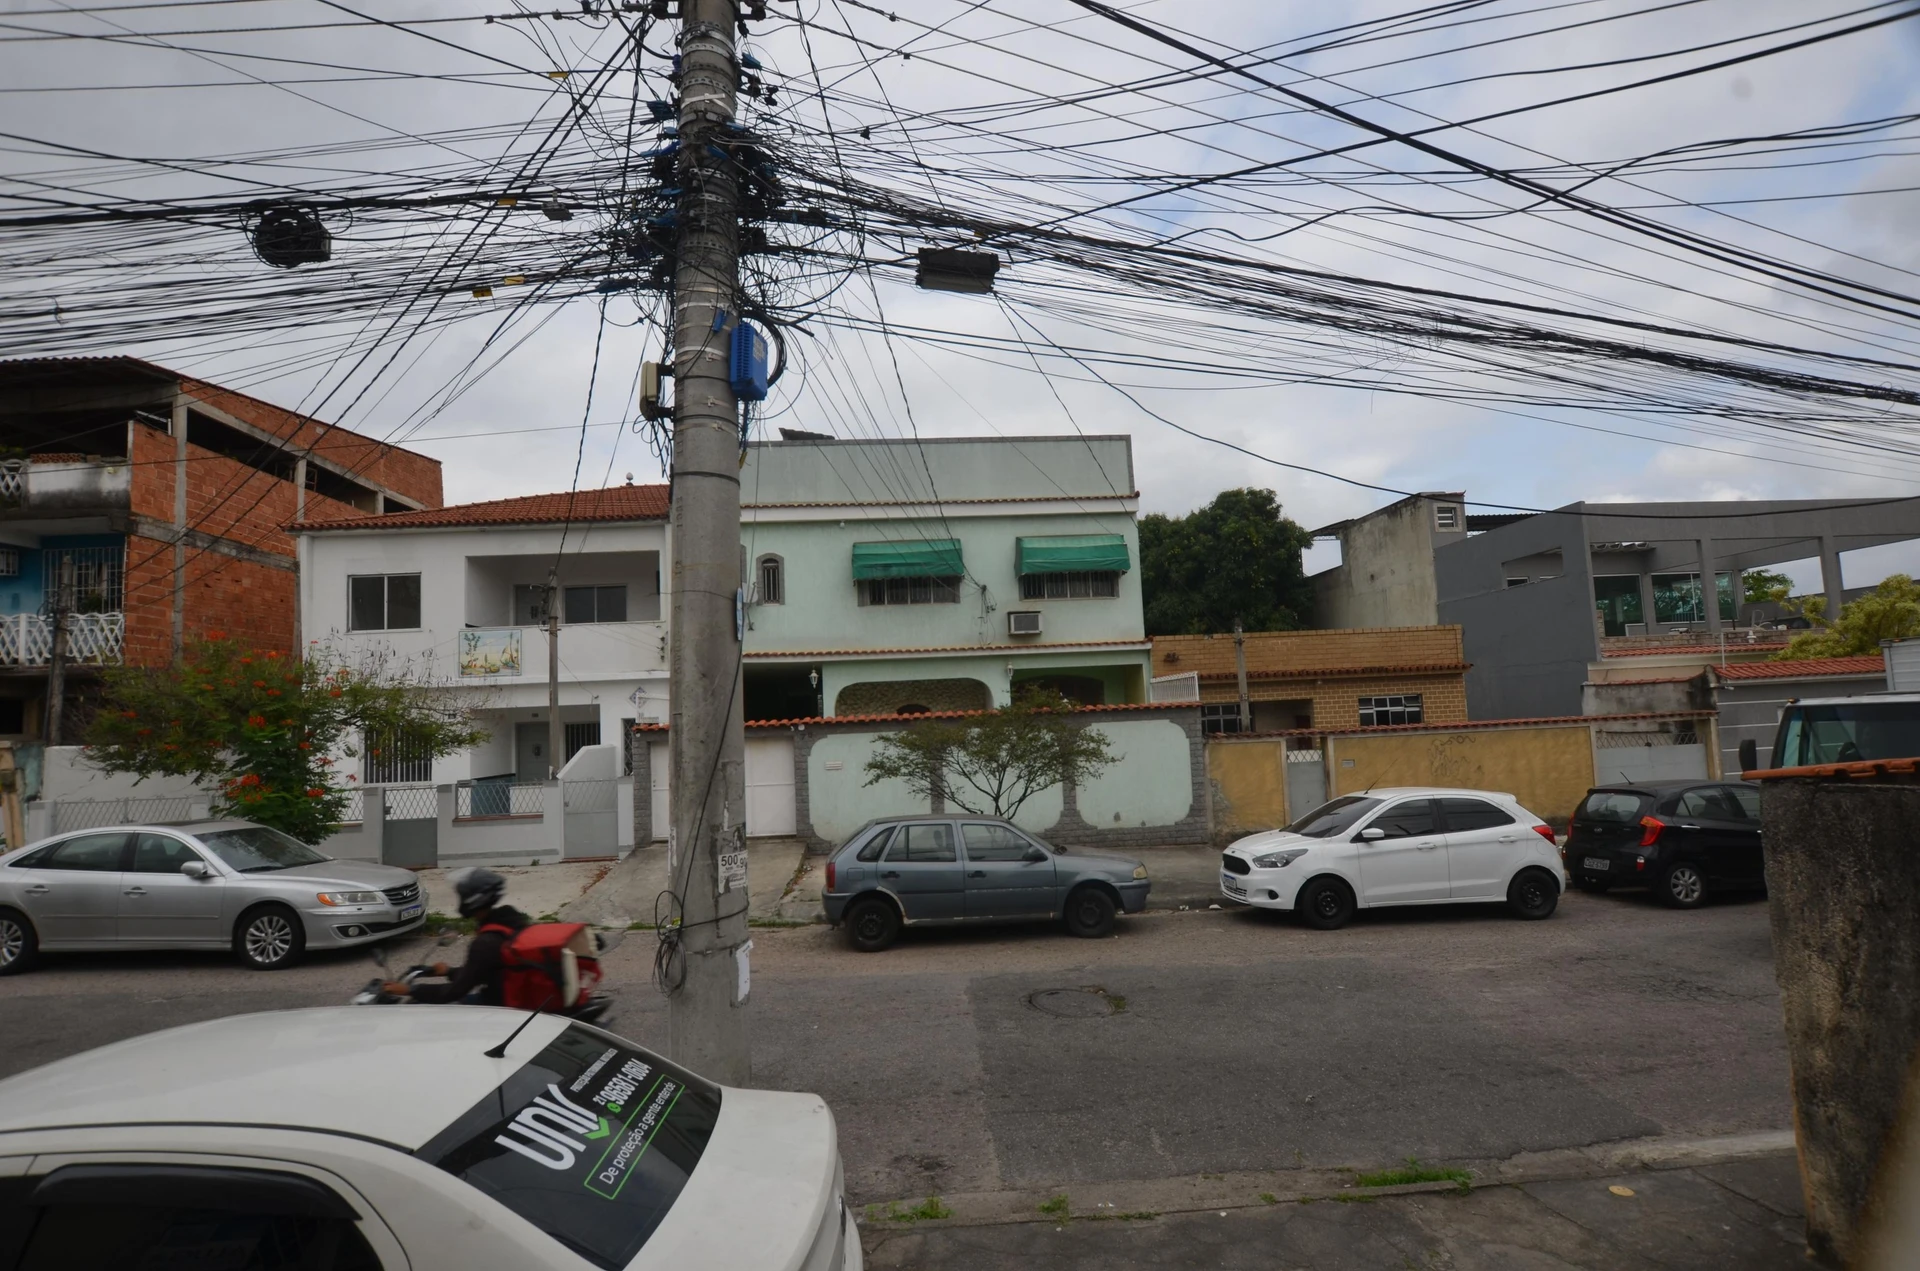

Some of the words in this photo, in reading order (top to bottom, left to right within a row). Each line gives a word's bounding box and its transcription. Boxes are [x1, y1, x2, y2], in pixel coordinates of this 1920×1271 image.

[721, 854, 738, 867] 500
[655, 1082, 676, 1106] entende
[642, 1102, 661, 1126] gente
[638, 1122, 649, 1131] a
[613, 1131, 643, 1169] proteção
[599, 1166, 619, 1185] De
